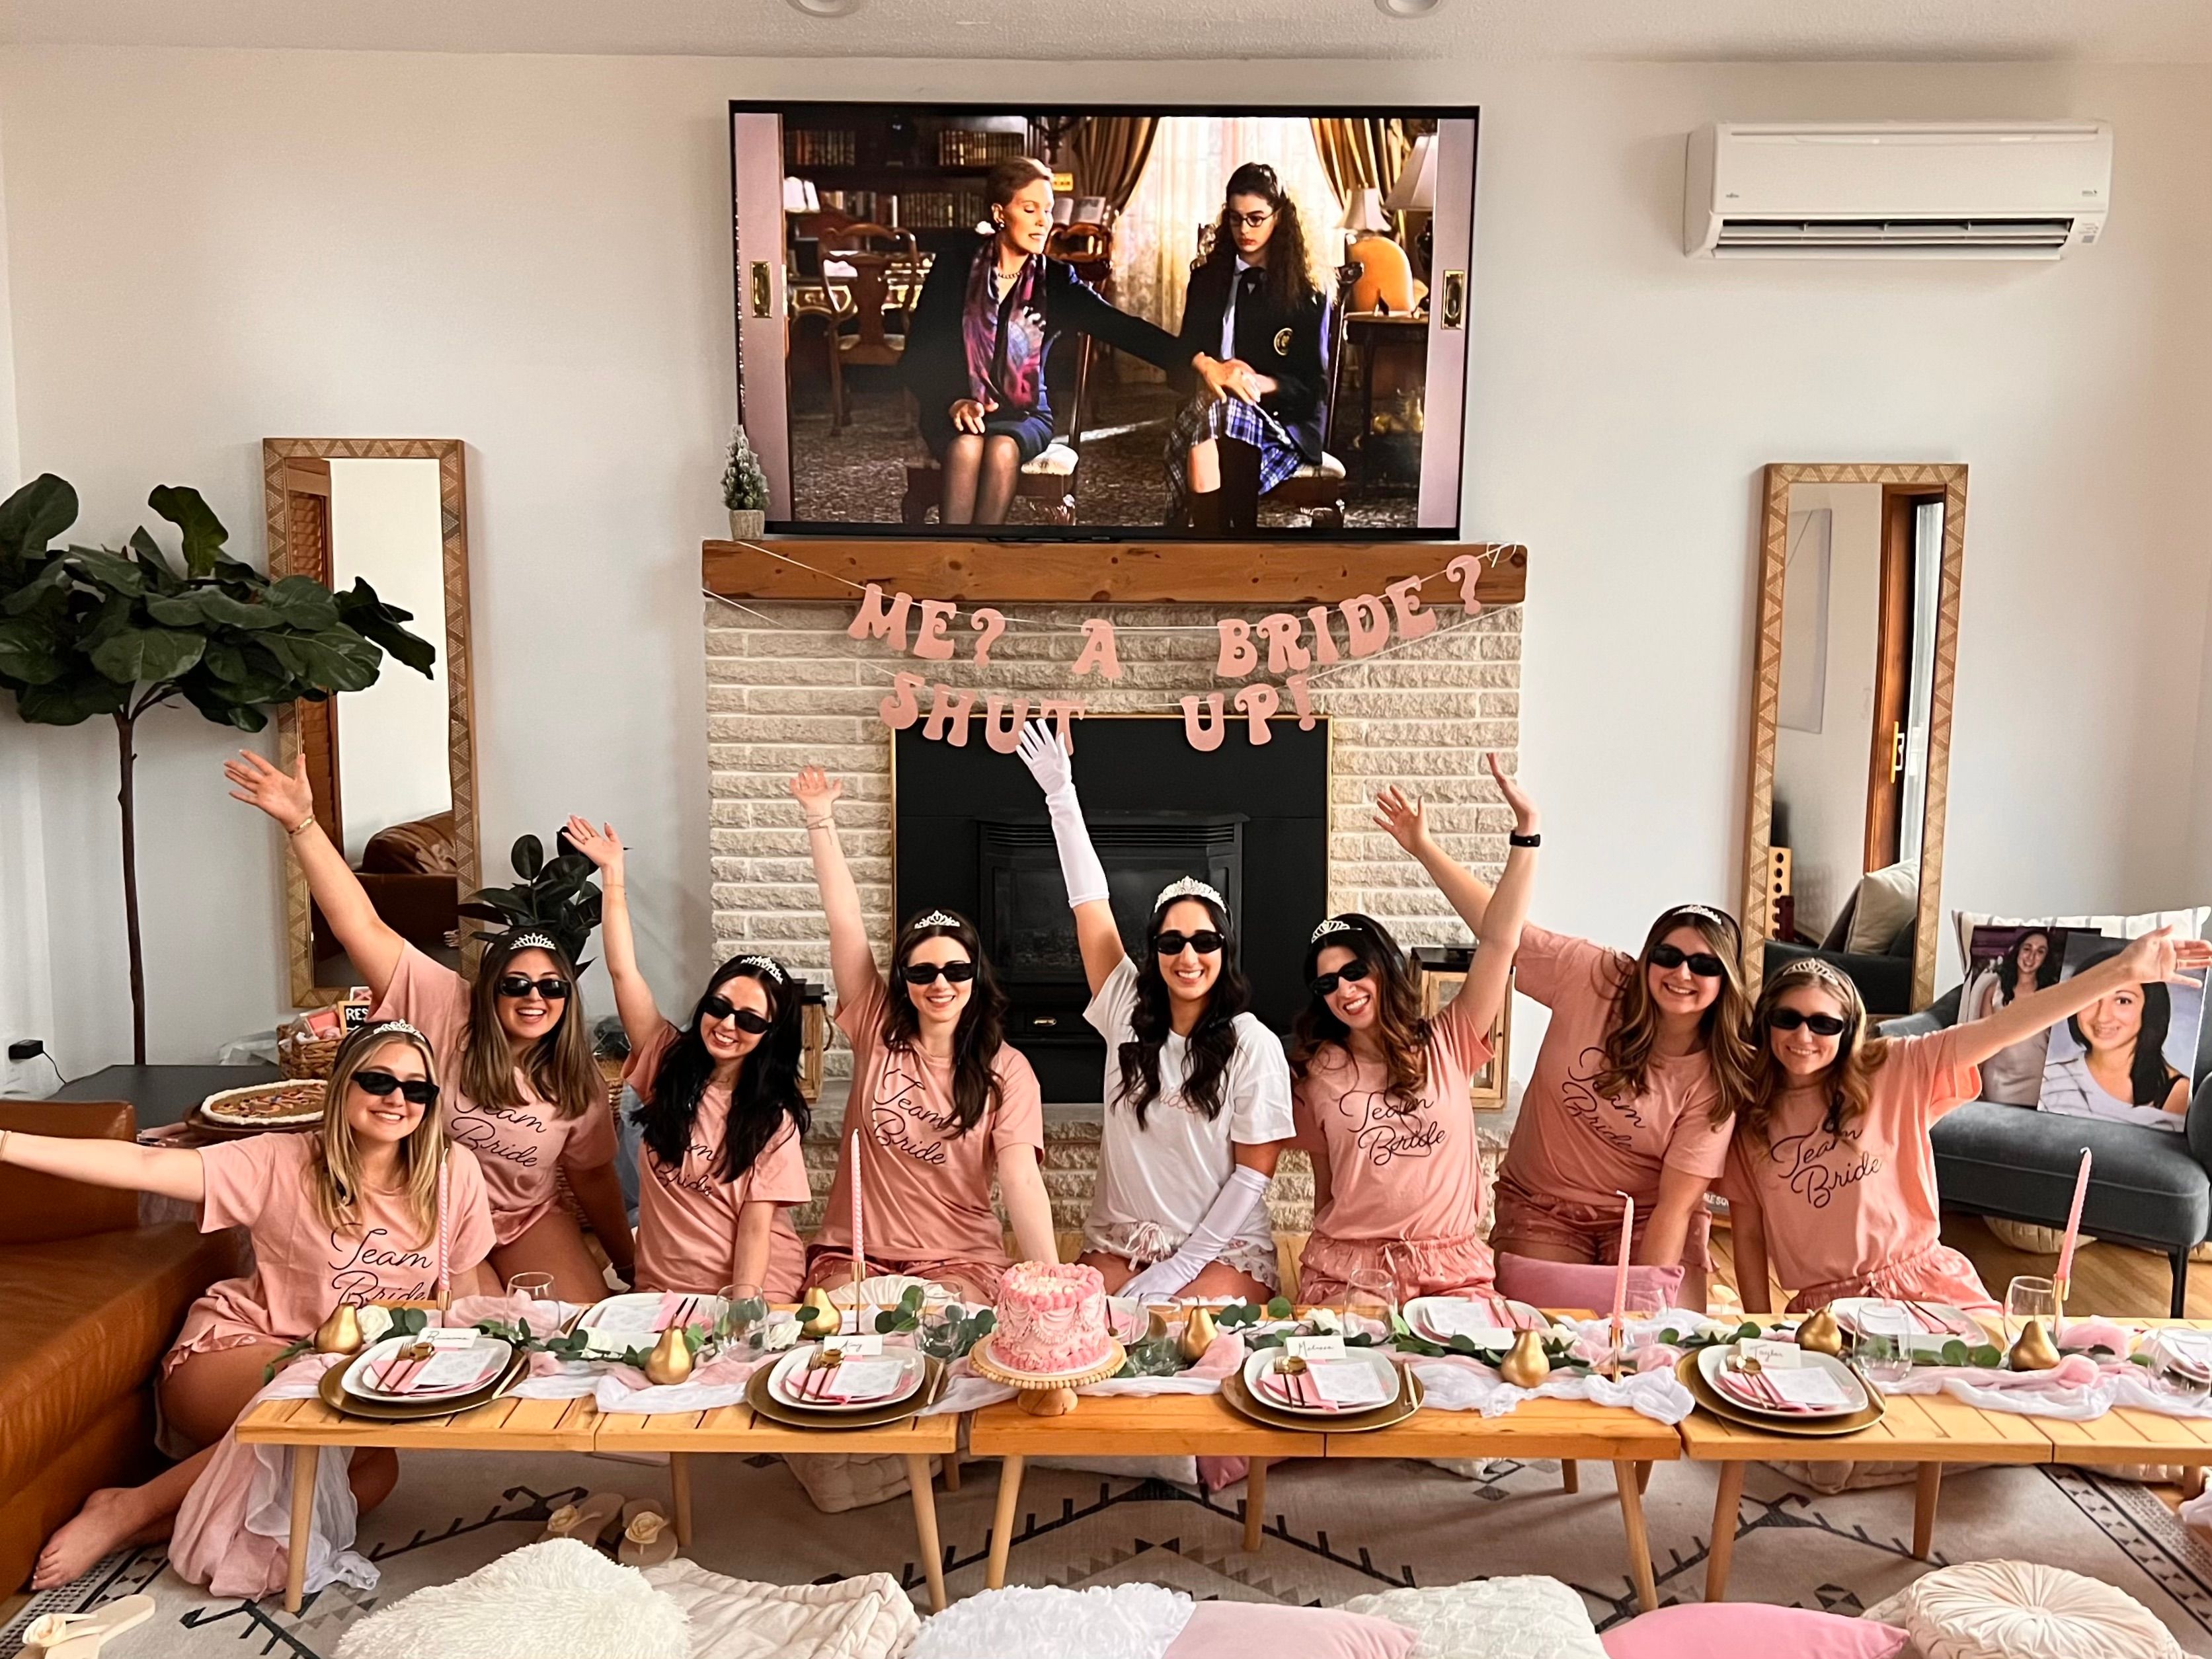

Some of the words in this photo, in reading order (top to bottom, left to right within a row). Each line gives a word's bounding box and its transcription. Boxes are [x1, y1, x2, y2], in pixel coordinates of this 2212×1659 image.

[848, 583, 1006, 668] ME?
[1071, 618, 1121, 679] A
[879, 671, 1086, 755] SHUT
[1180, 674, 1316, 752] UP!
[873, 1068, 946, 1131] Team
[451, 1116, 538, 1167] Bride
[871, 1107, 947, 1165] Bride
[1358, 1120, 1446, 1165] Bride
[1790, 1151, 1883, 1208] Bride
[328, 1222, 434, 1270] Team
